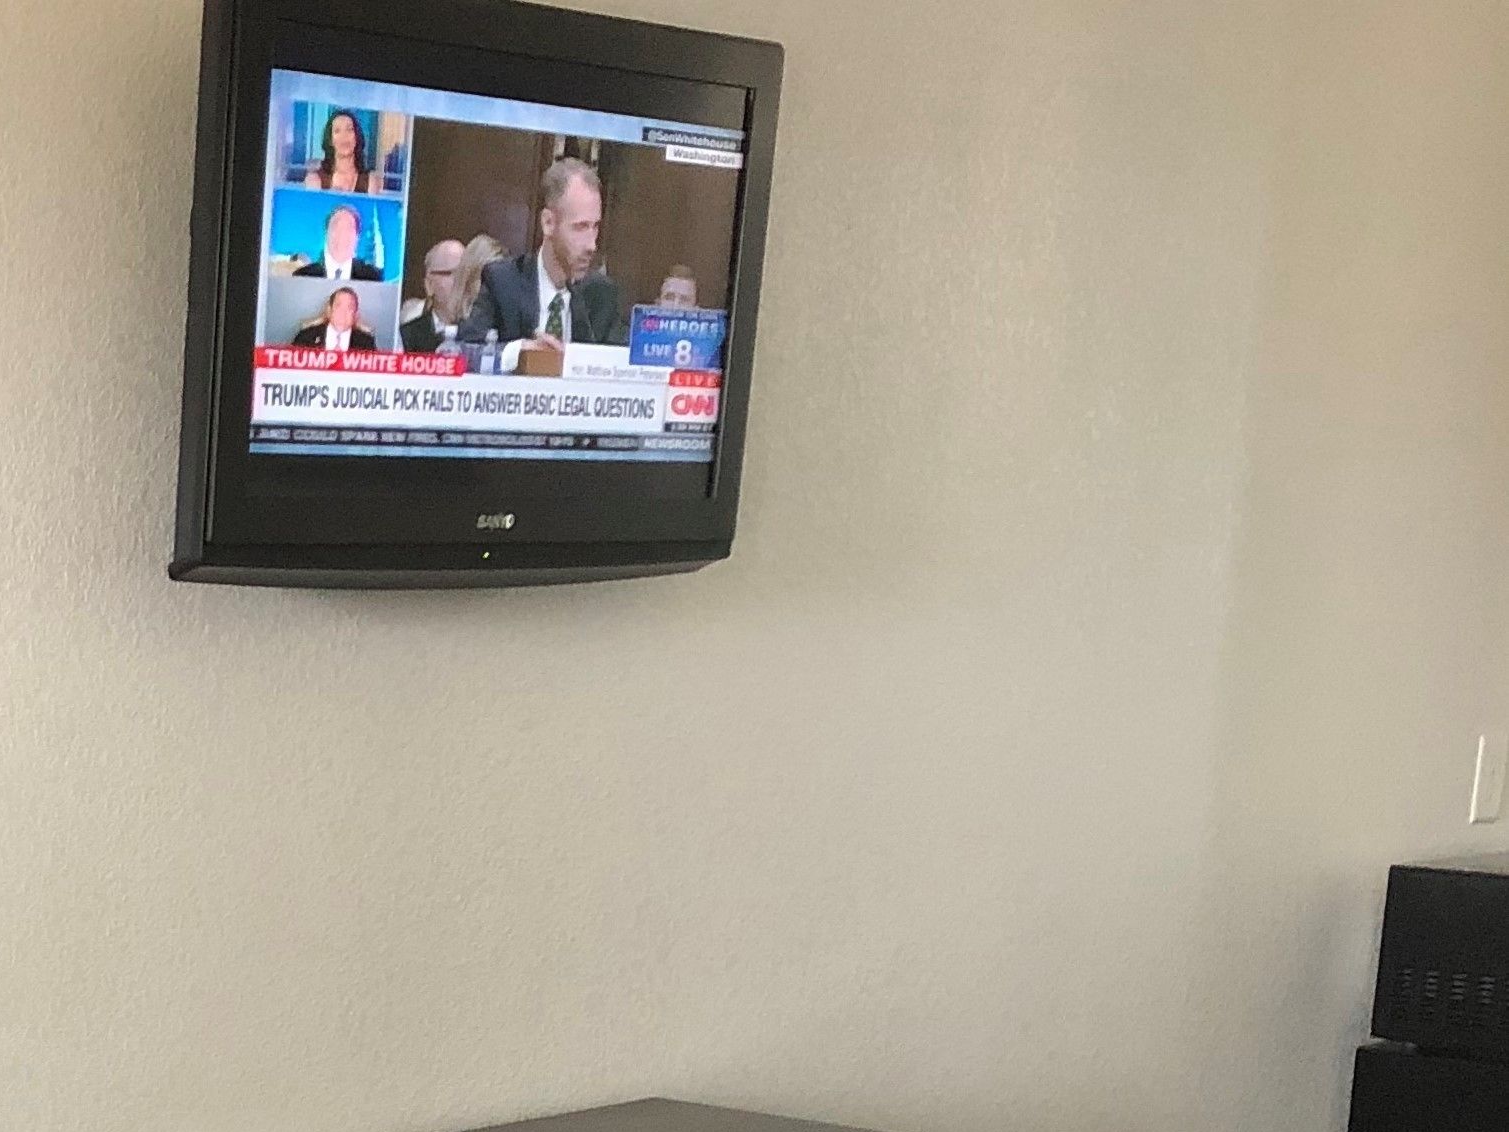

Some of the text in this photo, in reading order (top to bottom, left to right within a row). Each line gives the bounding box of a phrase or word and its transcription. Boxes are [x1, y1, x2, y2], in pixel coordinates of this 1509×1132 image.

[673, 148, 736, 166] Washington
[659, 319, 719, 334] HEROES
[264, 348, 456, 375] TRUMP WHITE HOUSE
[643, 339, 692, 366] LIVE 8
[674, 372, 717, 386] LIVE
[262, 382, 655, 419] TRUMP'S JUDICIAL PICK FAILS TO ANSWER BASIC LEGAL QUESTIONS
[671, 393, 715, 416] CNN
